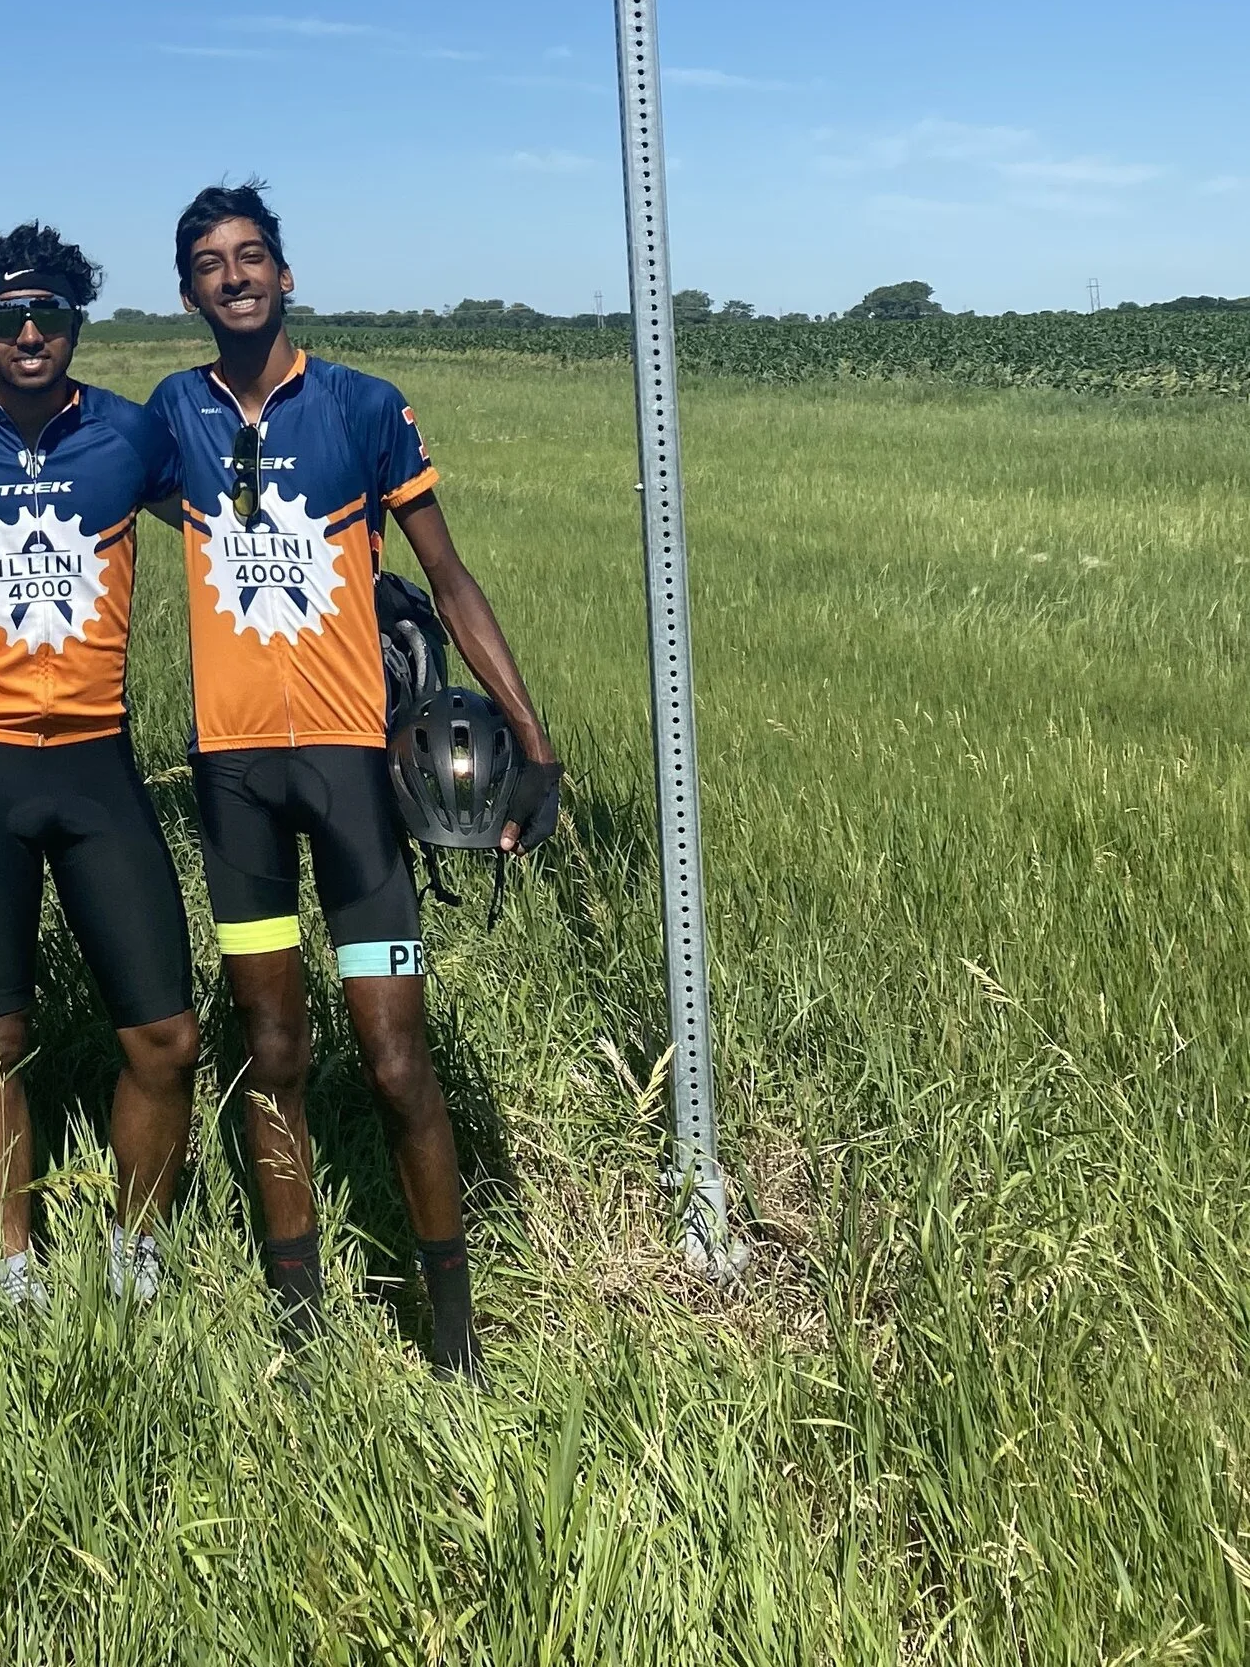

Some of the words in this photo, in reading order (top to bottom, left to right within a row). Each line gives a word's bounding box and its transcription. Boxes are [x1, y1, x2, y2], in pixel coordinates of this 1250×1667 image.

[219, 456, 297, 470] TEK
[223, 536, 313, 560] ILLINI
[235, 564, 305, 584] 4000
[8, 579, 72, 601] 4000
